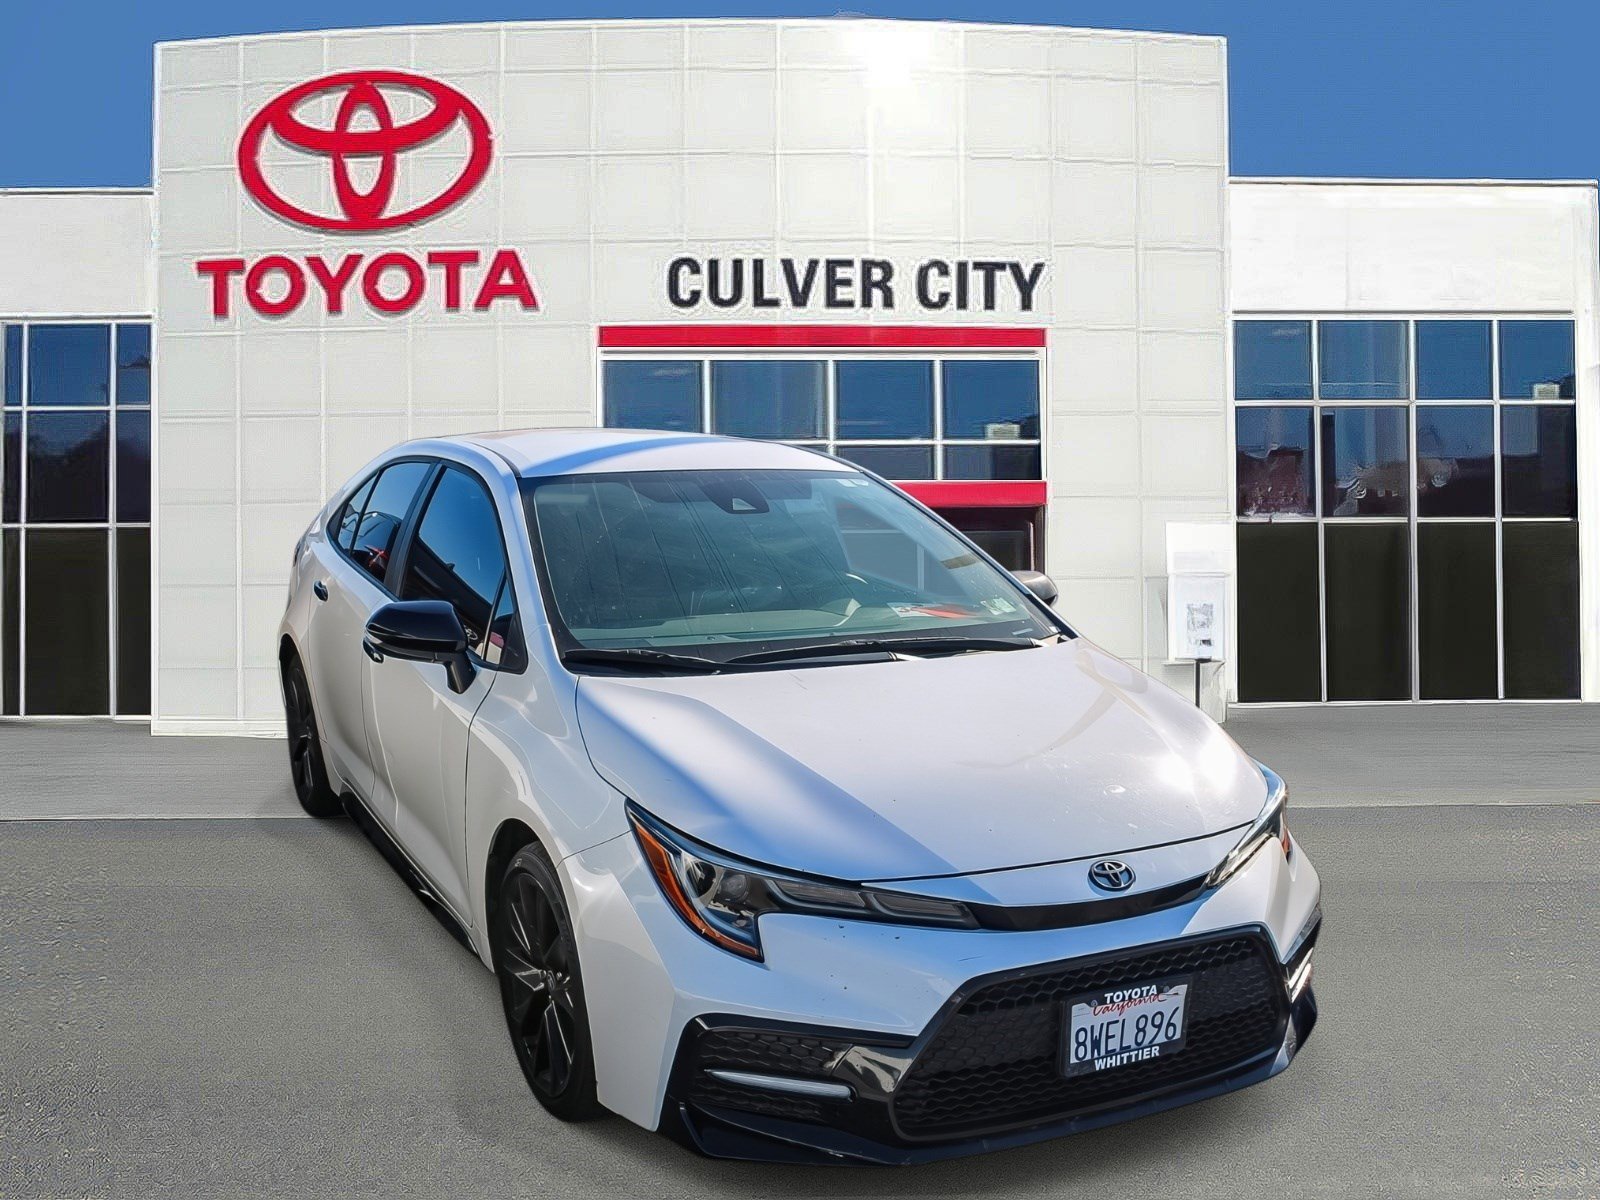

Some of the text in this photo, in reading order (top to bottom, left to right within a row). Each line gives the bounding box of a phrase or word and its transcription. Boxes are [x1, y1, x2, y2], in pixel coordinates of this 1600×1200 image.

[196, 249, 540, 318] TOYOTA
[667, 257, 1046, 312] CULVER CITY
[1104, 985, 1158, 1004] TOYOTA
[1074, 1006, 1180, 1062] 8WEL896
[1094, 1046, 1160, 1071] WHITTIER
